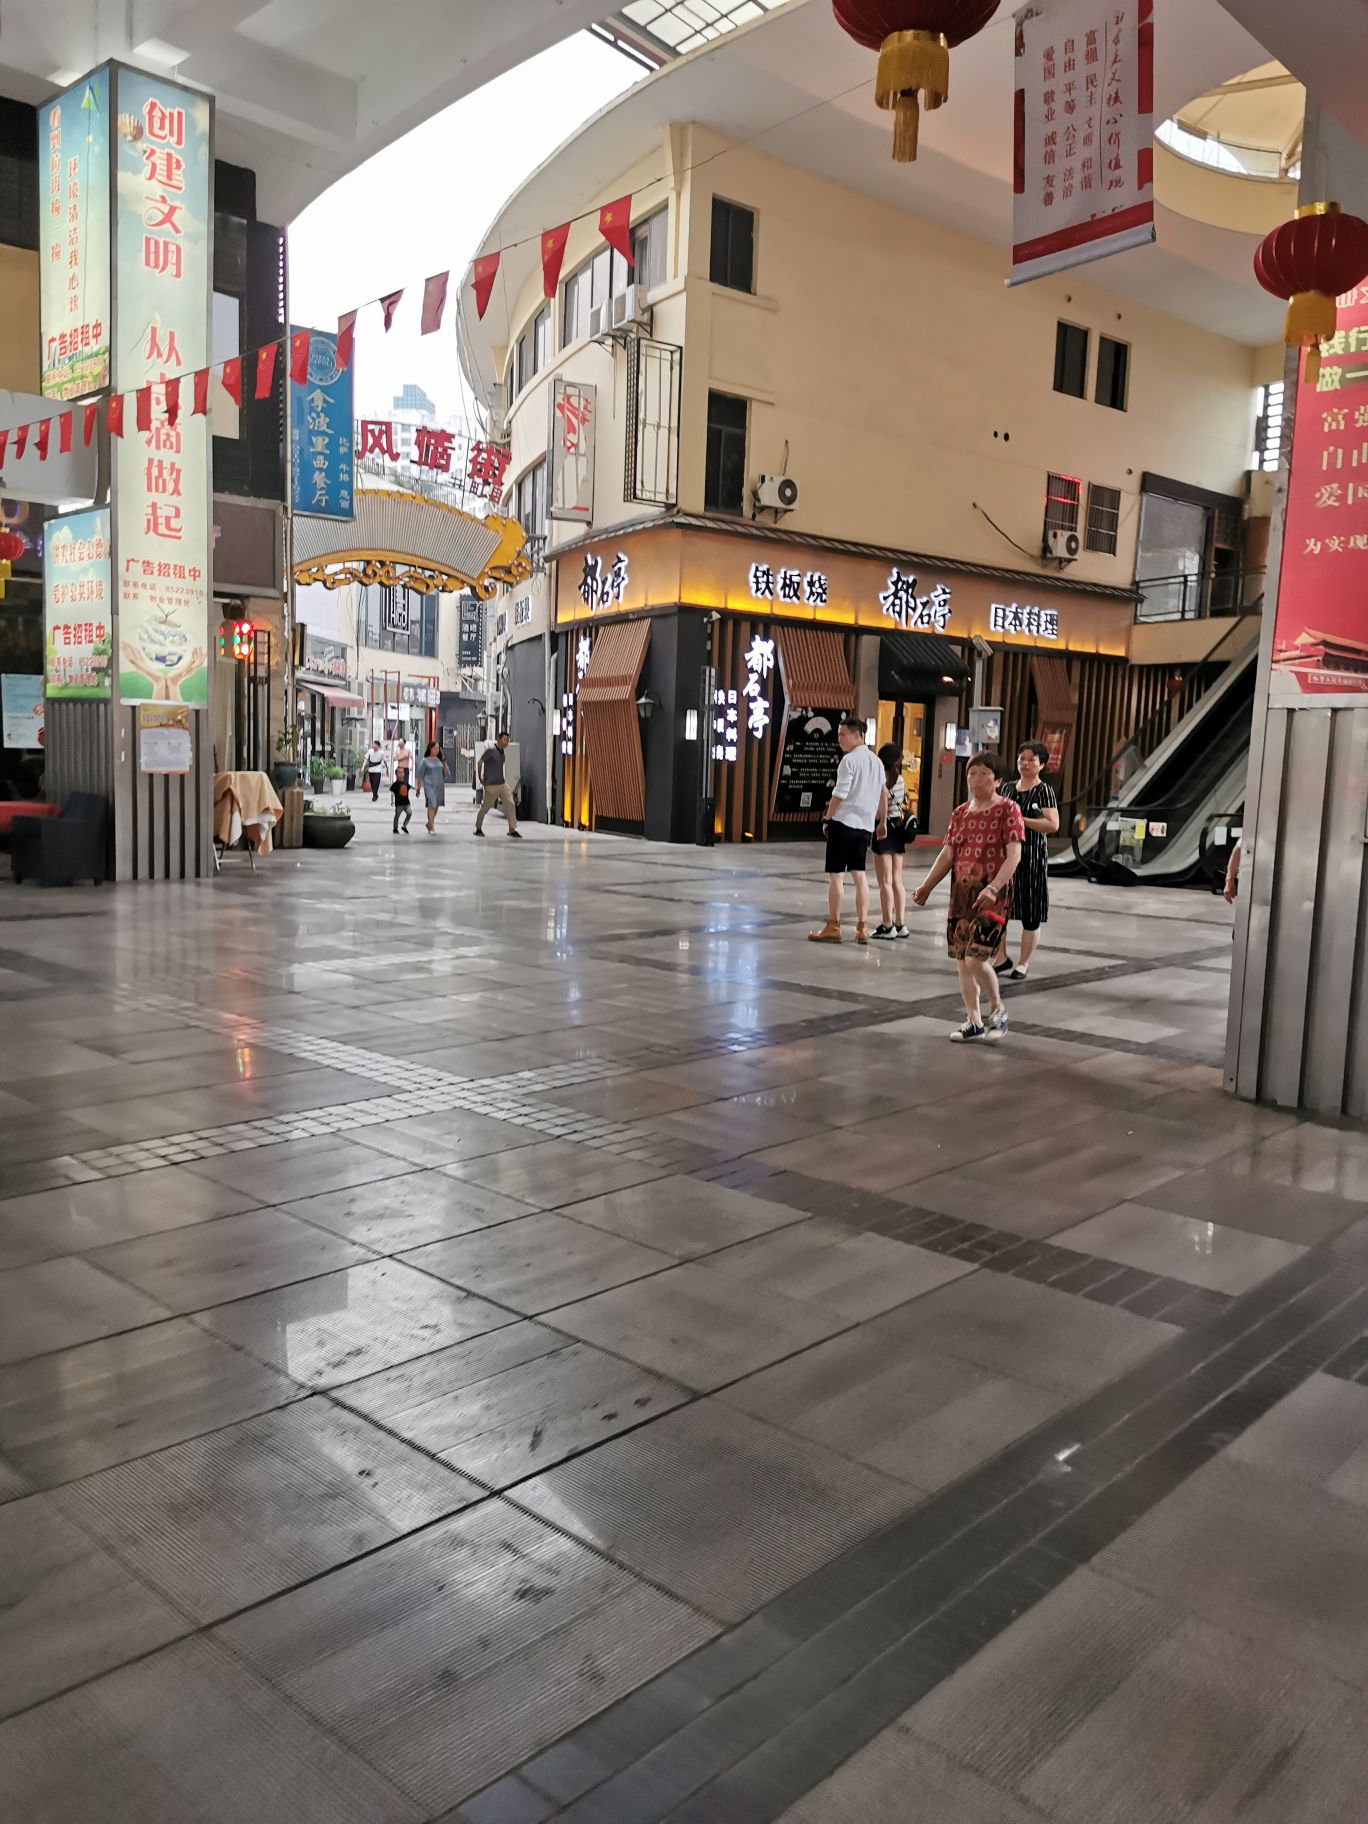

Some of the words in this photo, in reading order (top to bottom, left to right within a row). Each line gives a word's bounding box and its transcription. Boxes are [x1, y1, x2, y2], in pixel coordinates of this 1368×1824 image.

[143, 97, 186, 281] 创建文明
[47, 319, 103, 361] 广告招租中
[125, 557, 202, 582] 广告招租中
[750, 562, 829, 606] 铁板烧
[51, 622, 106, 646] 广告招租中
[990, 603, 1060, 639] 日本料理
